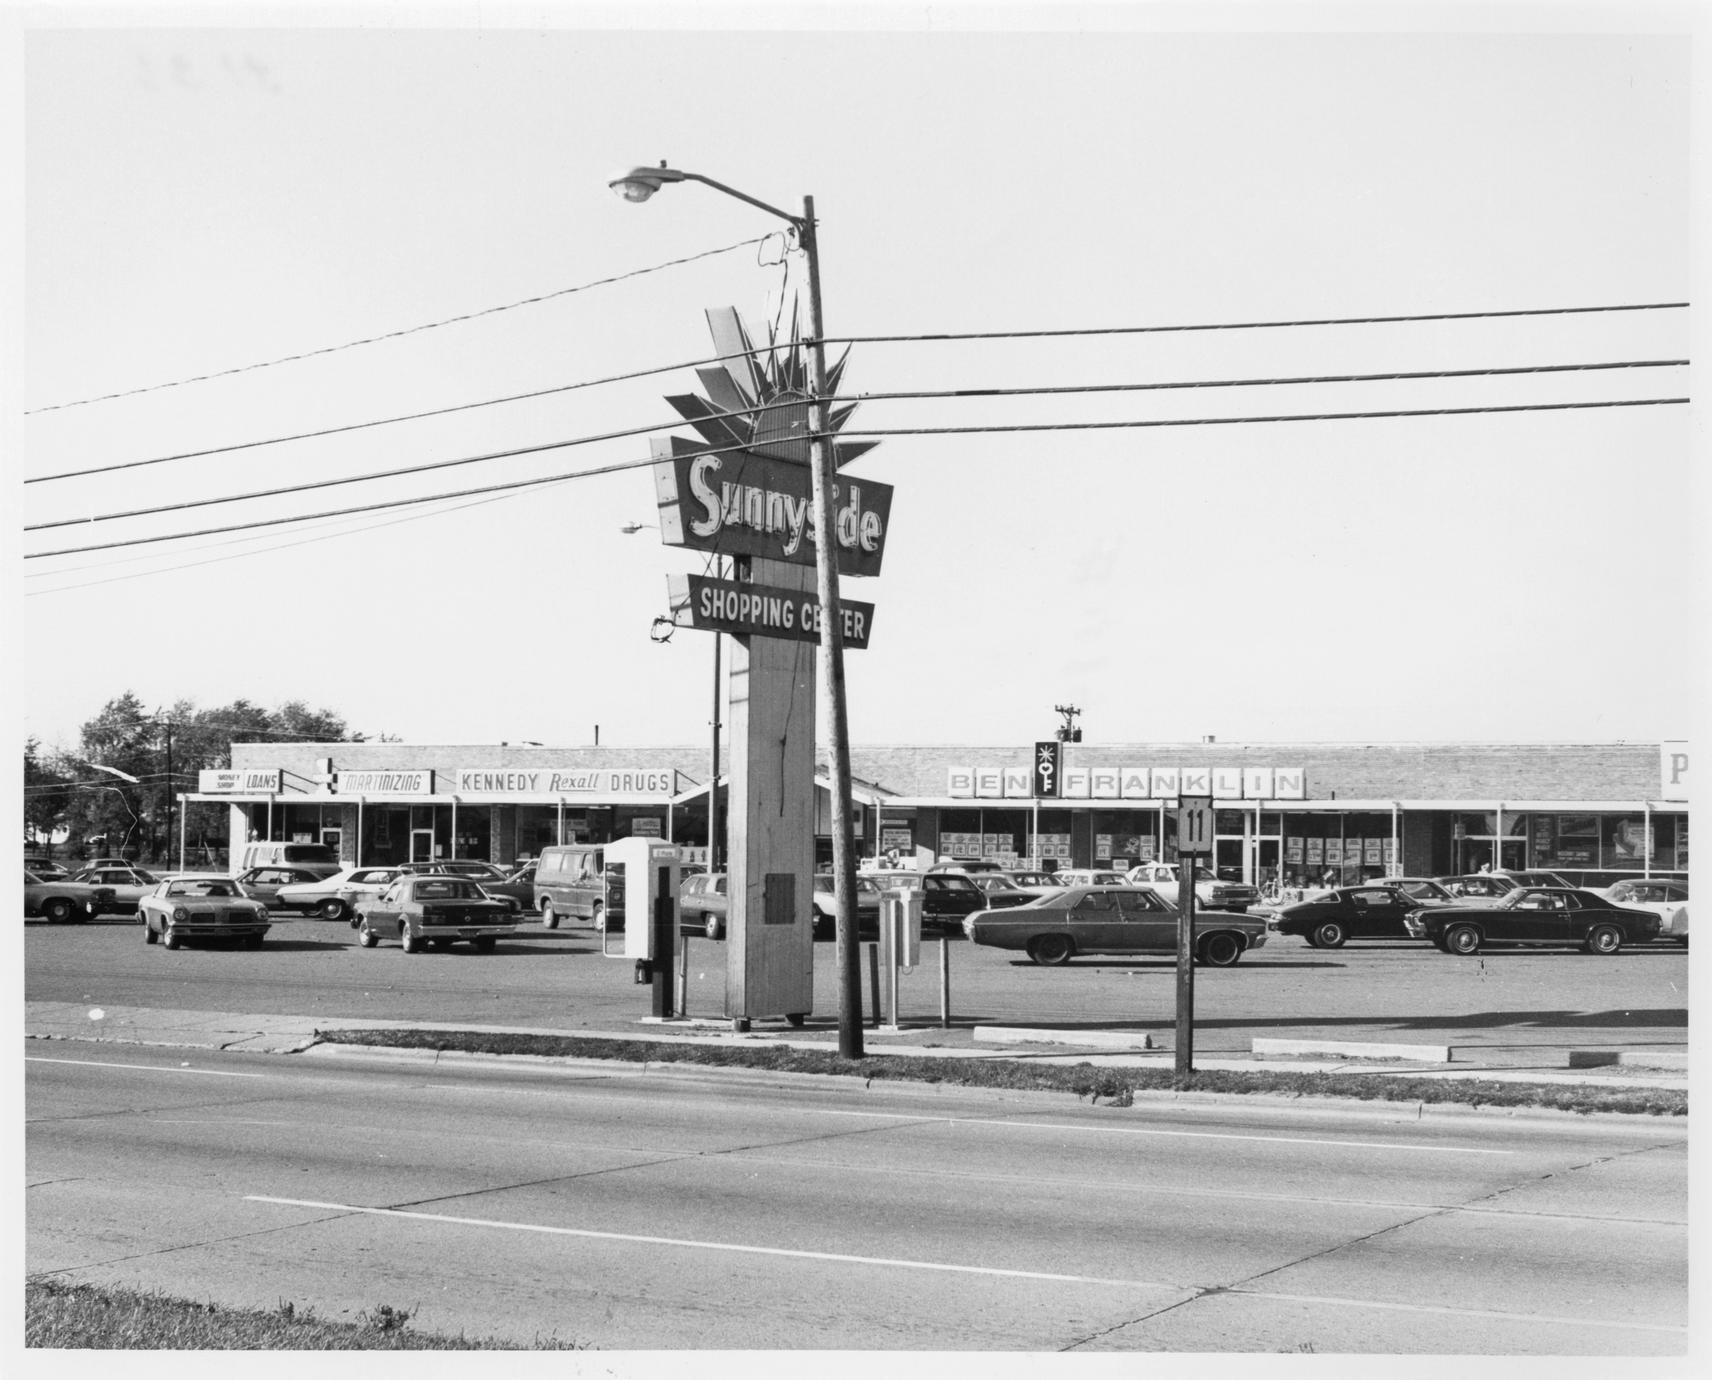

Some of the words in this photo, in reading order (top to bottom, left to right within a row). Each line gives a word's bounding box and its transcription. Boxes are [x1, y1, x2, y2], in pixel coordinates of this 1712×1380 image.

[689, 454, 882, 556] Sunnyde
[701, 587, 794, 629] SHOPPING
[801, 602, 865, 640] CEER
[246, 774, 278, 788] LOANS
[345, 774, 422, 791] MARTINIZING
[462, 773, 538, 791] KENNEDY
[550, 773, 600, 792] Rexall
[611, 774, 669, 791] DRUGS
[951, 775, 1027, 789] BEN
[1066, 775, 1300, 790] FRANKLIN
[1187, 809, 1203, 842] 11
